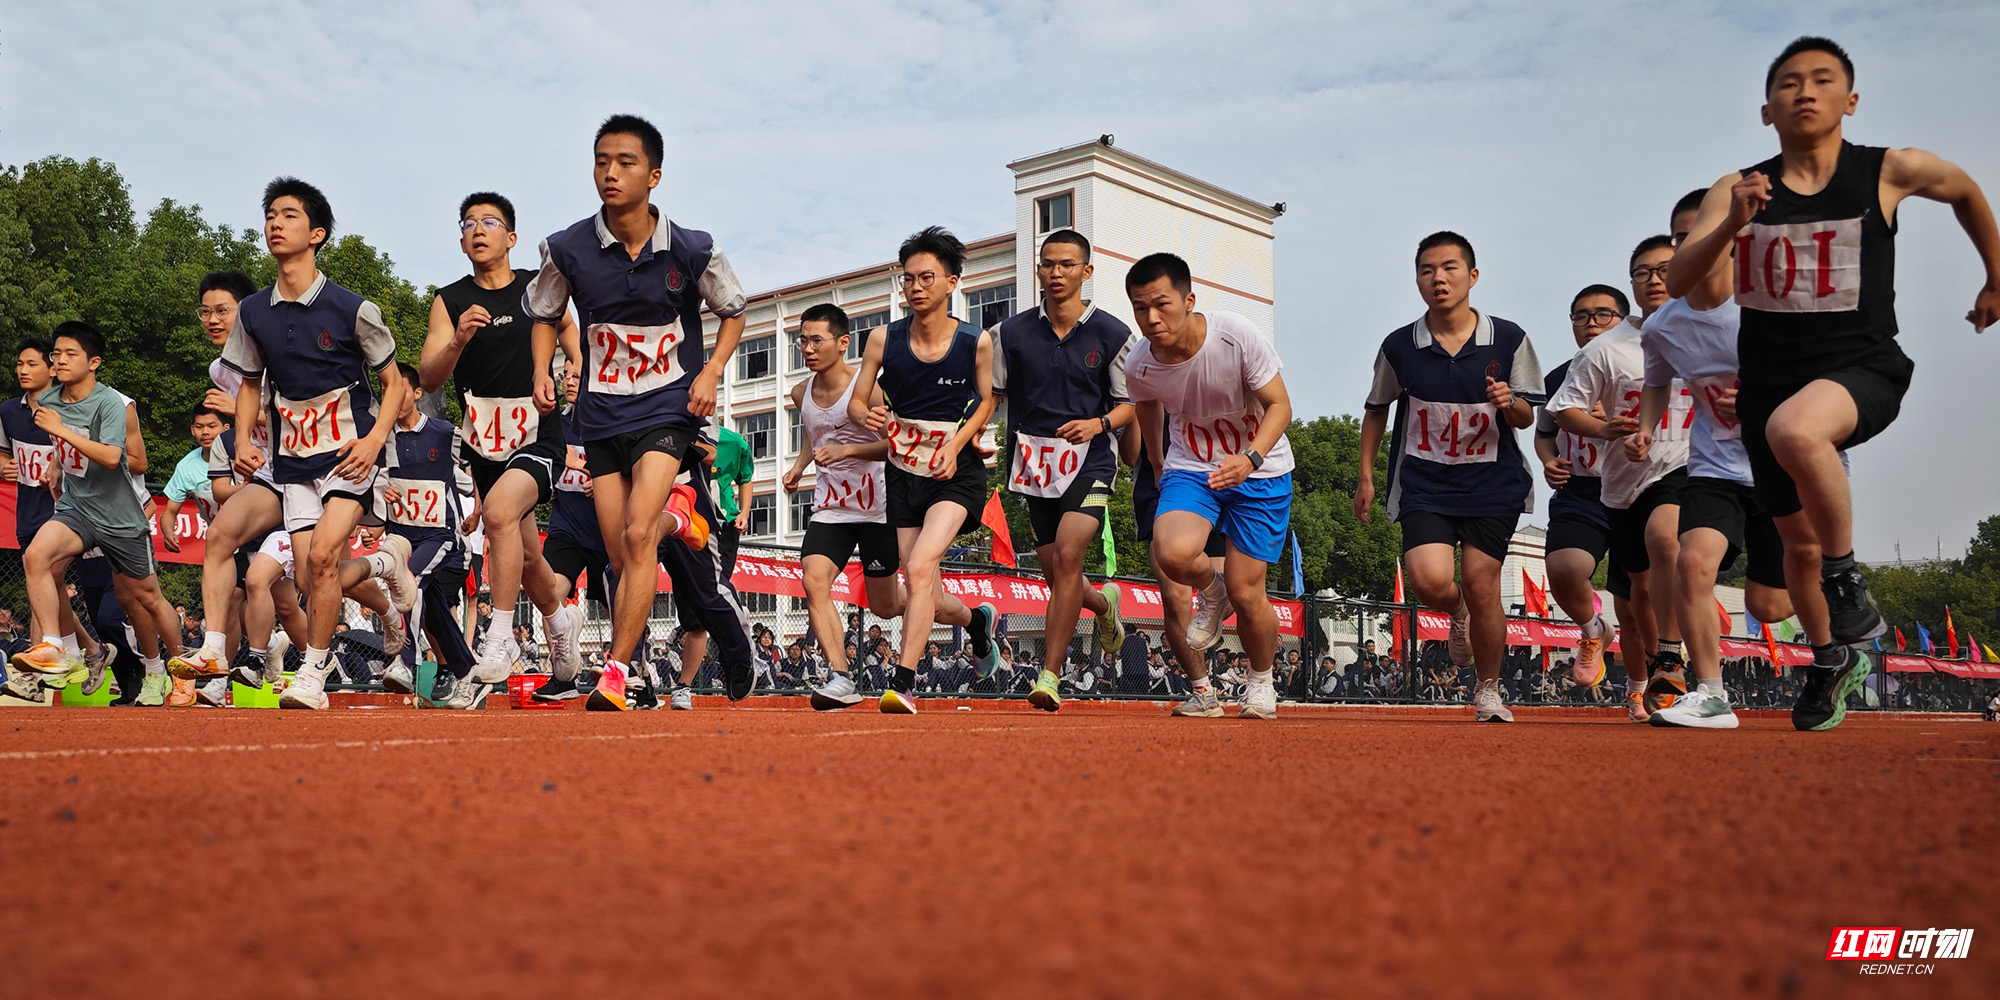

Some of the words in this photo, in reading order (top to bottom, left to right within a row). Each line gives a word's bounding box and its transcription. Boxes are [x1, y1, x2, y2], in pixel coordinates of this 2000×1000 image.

[1736, 230, 1836, 299] 101
[597, 332, 676, 384] 256
[888, 421, 946, 470] 327
[1417, 408, 1490, 458] 142
[1015, 444, 1078, 488] 250
